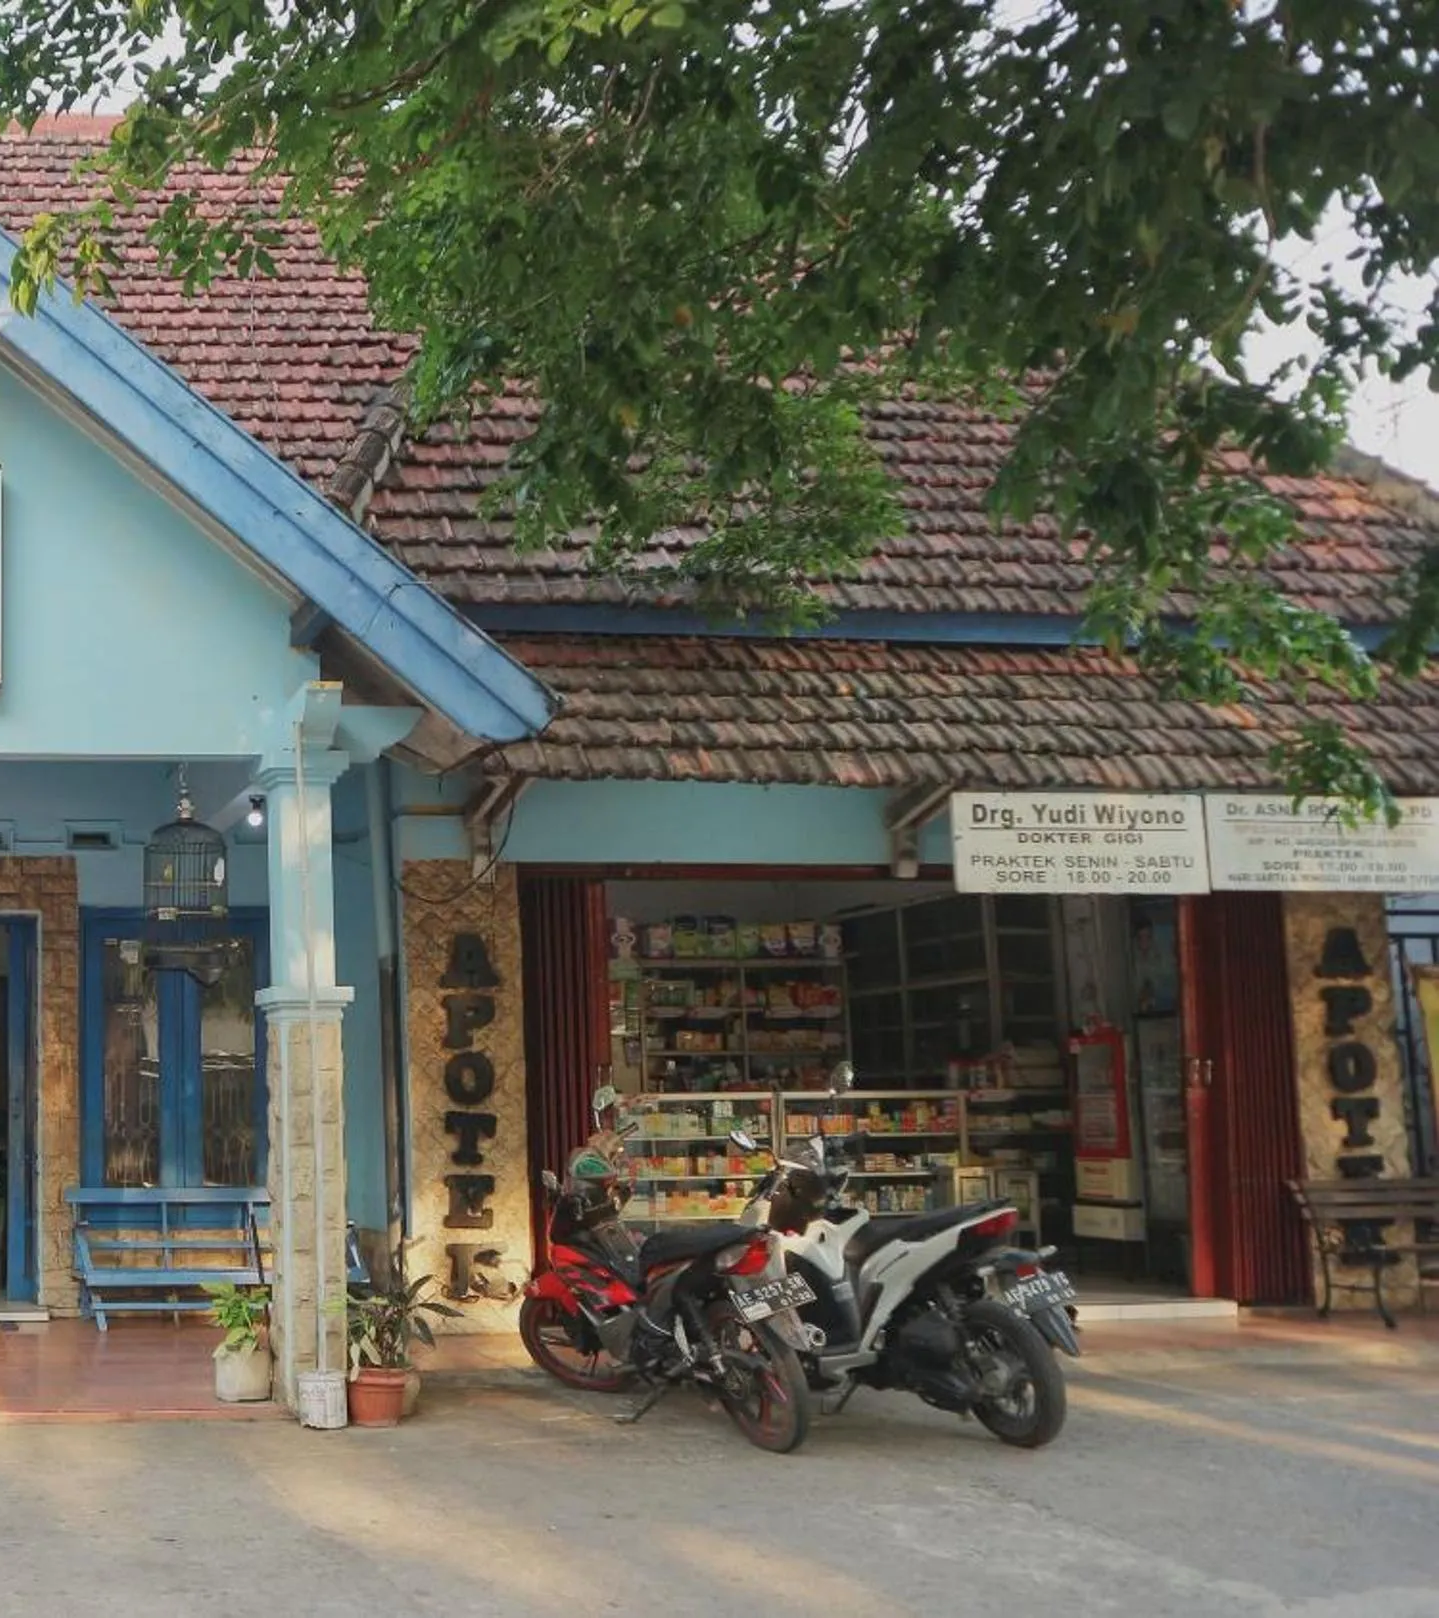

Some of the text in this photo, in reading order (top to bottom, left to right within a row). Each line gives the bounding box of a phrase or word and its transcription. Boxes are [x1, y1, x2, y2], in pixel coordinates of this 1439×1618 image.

[972, 803, 1185, 829] Drg. Yudi Wiyono
[1018, 832, 1144, 845] DOKTER GIGI
[971, 855, 1056, 868] PRAKTEK
[1064, 855, 1118, 868] SENIN
[1135, 856, 1194, 869] SABTU
[996, 871, 1047, 883] SORE
[1067, 871, 1111, 884] 18.00
[1127, 871, 1171, 884] 20.00
[439, 931, 517, 1302] APOTEK
